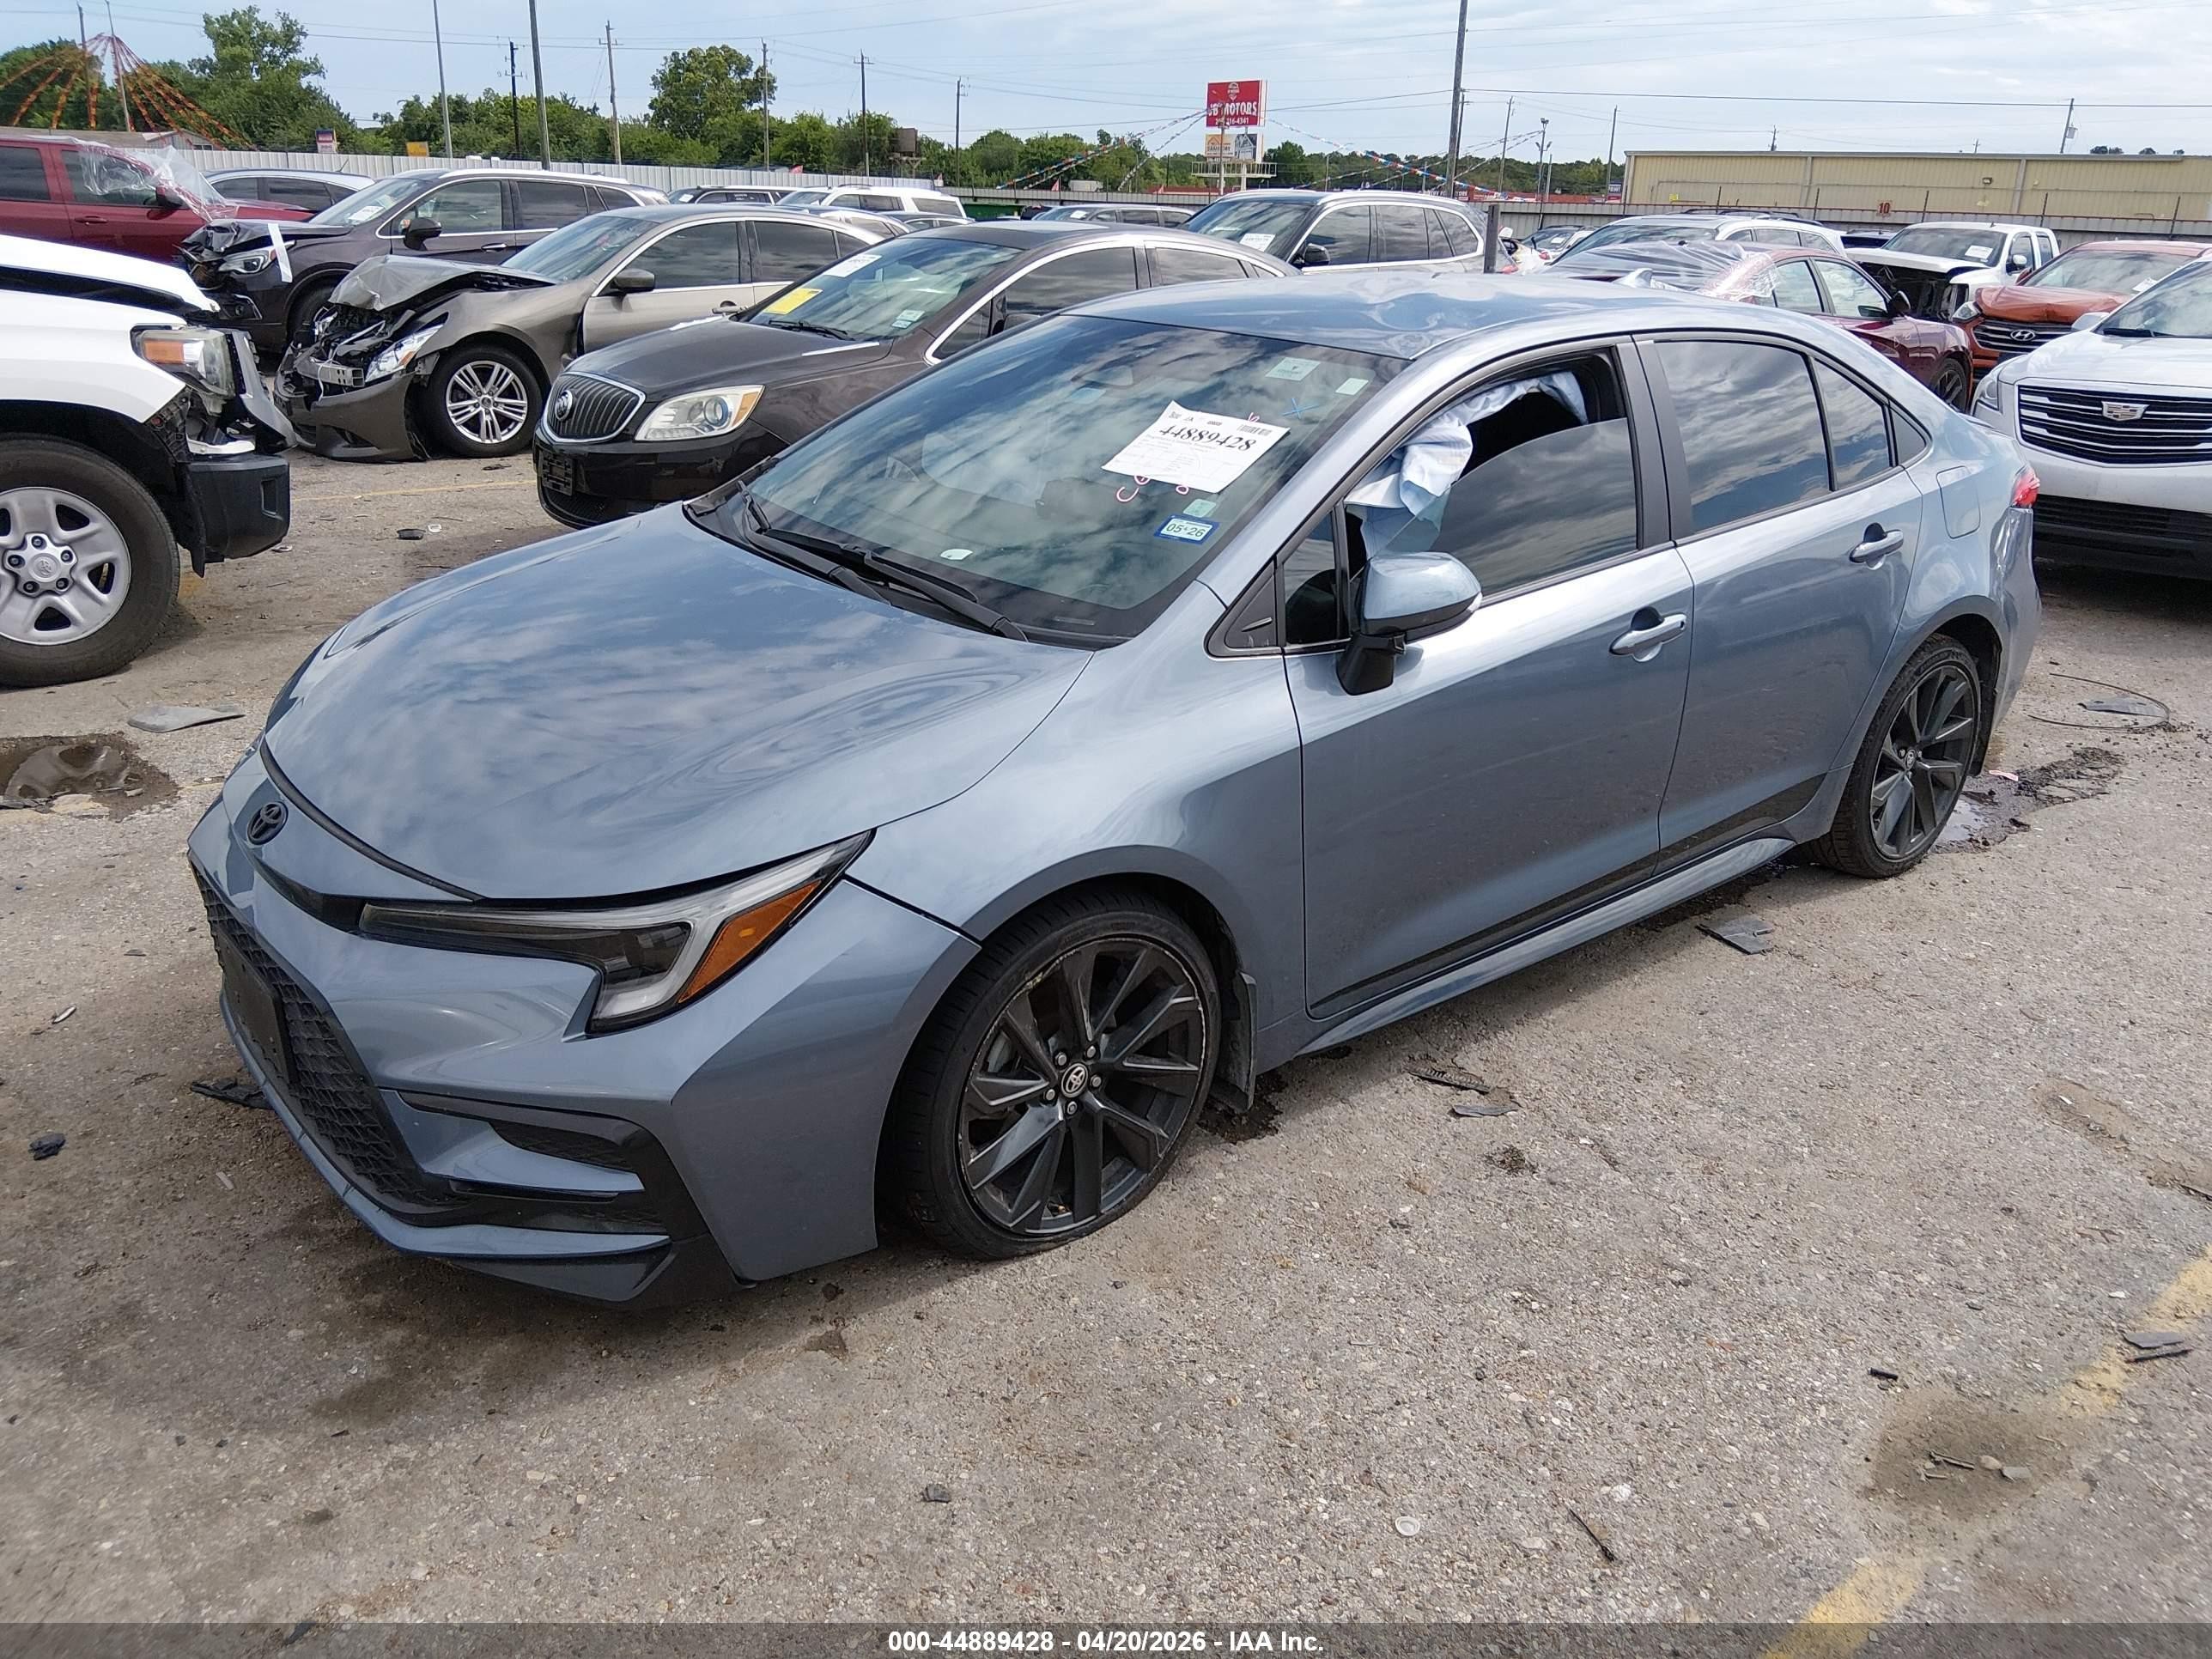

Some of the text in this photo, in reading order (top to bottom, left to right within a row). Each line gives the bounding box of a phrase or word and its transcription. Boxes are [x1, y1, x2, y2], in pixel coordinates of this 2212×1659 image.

[1221, 101, 1257, 117] MOTORS
[1879, 202, 1891, 214] 10
[1158, 424, 1257, 452] 44889428
